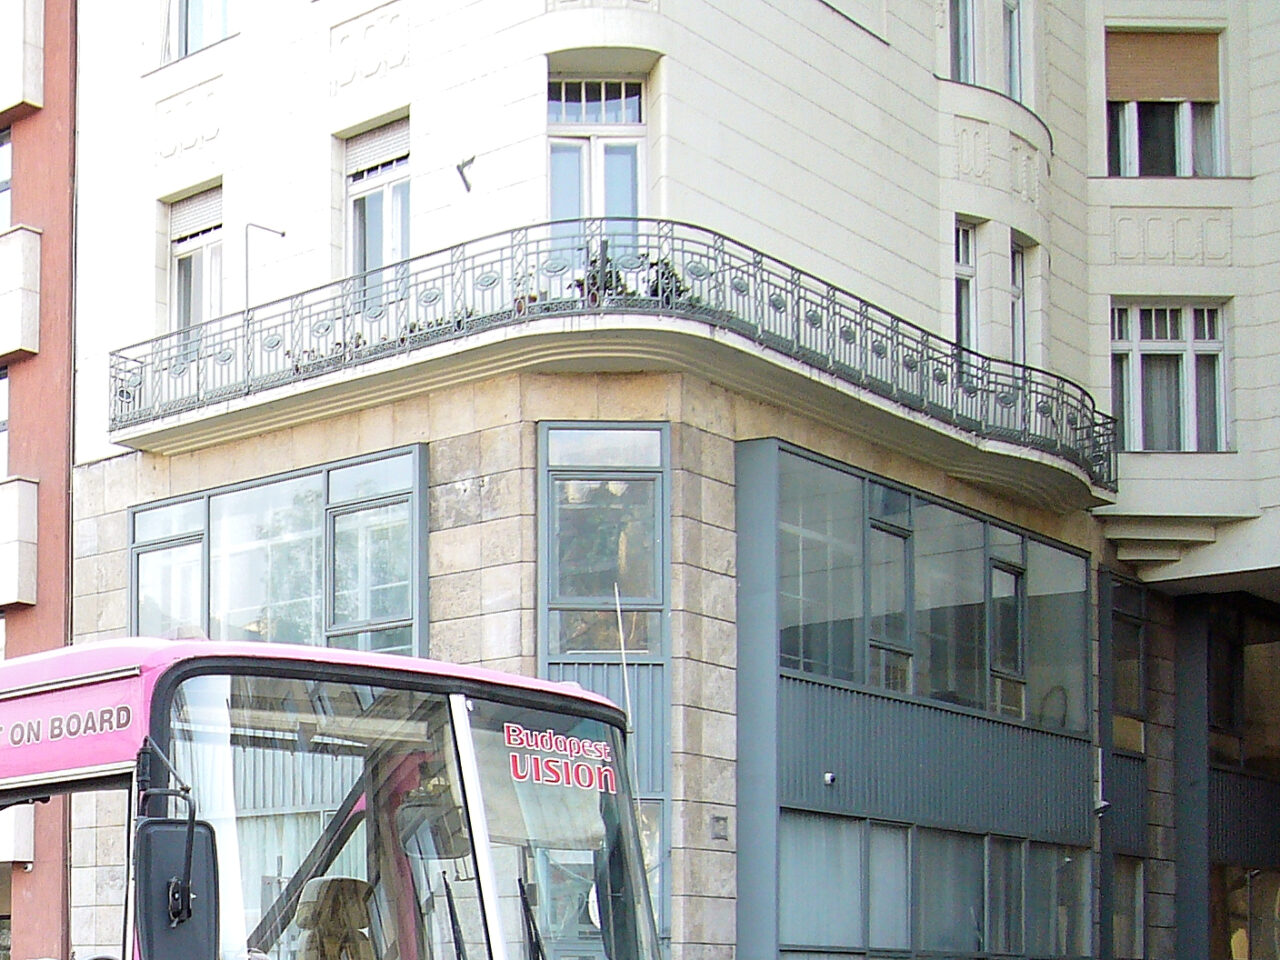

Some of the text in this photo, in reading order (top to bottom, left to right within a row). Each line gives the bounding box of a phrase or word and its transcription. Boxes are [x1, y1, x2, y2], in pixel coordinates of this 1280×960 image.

[9, 719, 41, 746] ON
[49, 705, 132, 740] BOARD
[503, 722, 612, 762] Budapest
